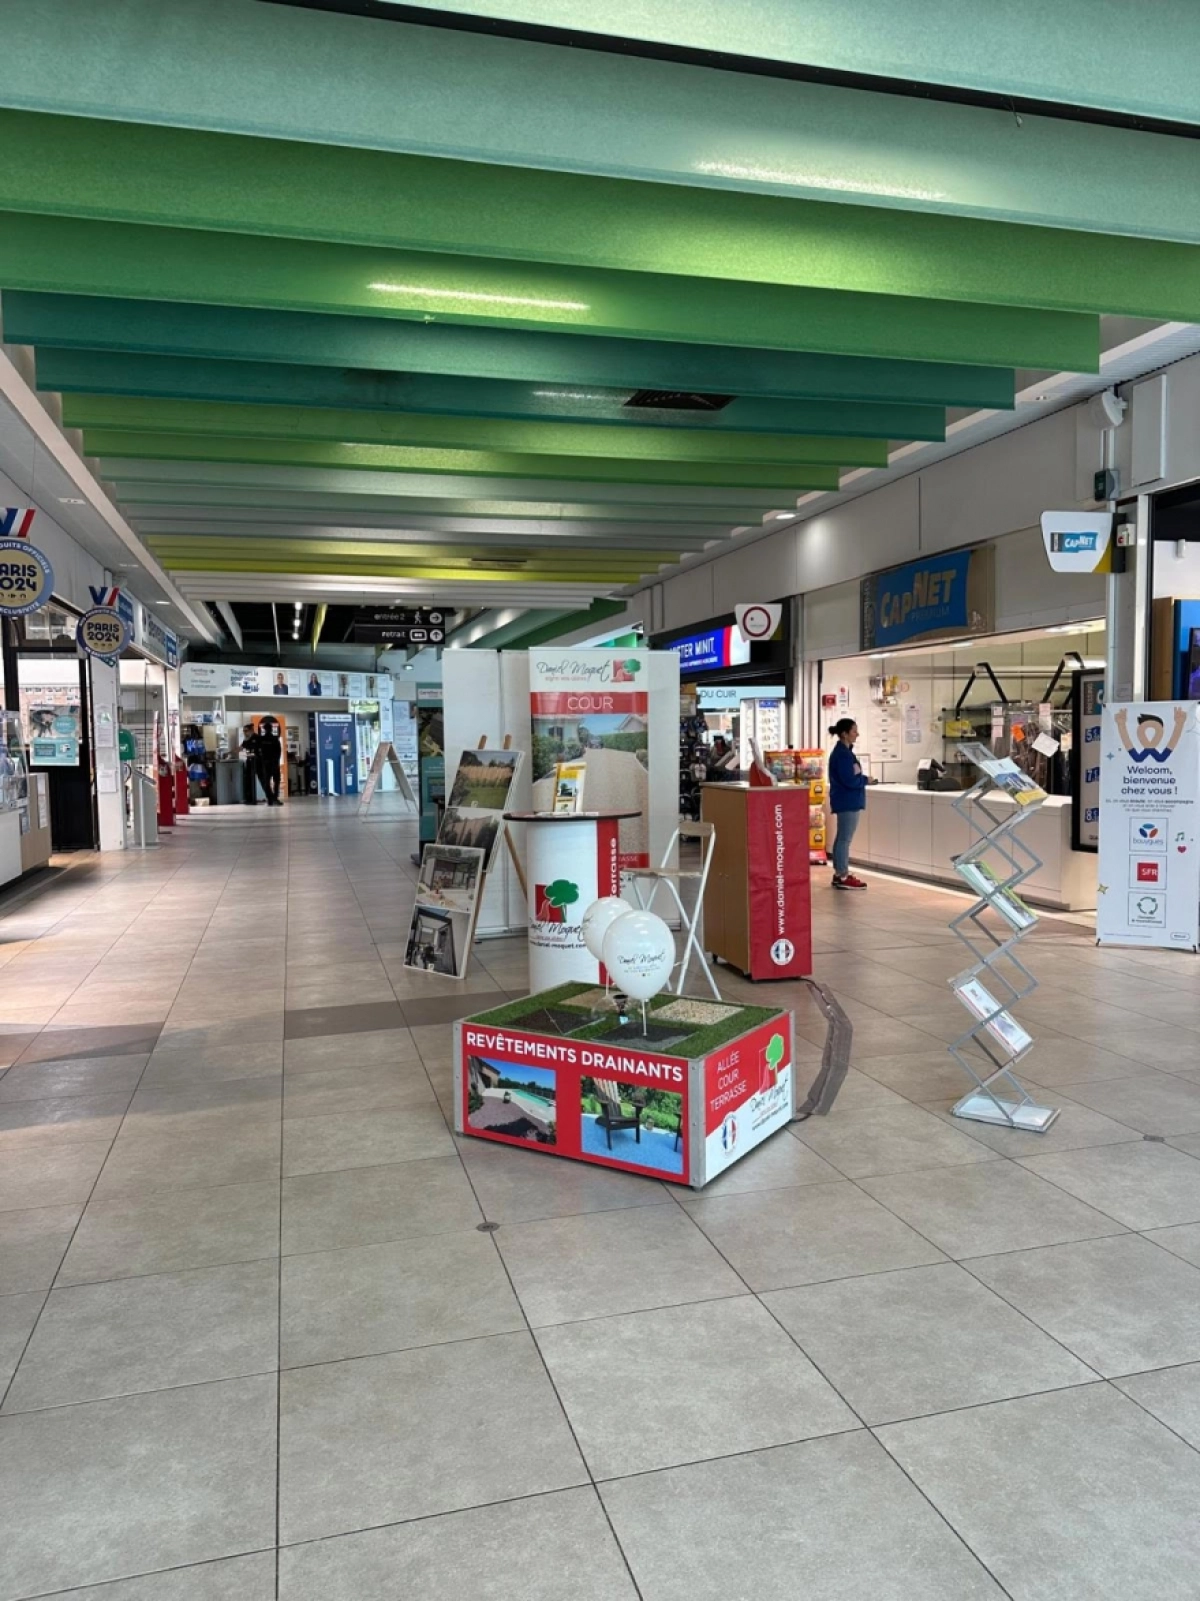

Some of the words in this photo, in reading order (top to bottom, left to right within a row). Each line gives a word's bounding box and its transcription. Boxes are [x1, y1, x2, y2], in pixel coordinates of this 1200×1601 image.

[0, 563, 37, 577] ARIS
[0, 577, 37, 591] 024
[374, 612, 399, 621] entrée
[400, 613, 405, 621] 2
[87, 622, 119, 633] PARIS
[87, 632, 119, 643] 2024
[695, 636, 715, 655] MINIT
[568, 659, 611, 682] Moquet
[716, 690, 737, 698] CUIR
[567, 695, 614, 710] COUR
[1127, 765, 1173, 775] Welcom,
[1123, 775, 1176, 785] bienvenue
[1121, 786, 1146, 795] chez
[1148, 787, 1172, 795] vous
[1174, 786, 1178, 795] !
[1132, 838, 1164, 846] bouygues
[775, 804, 785, 935] www.daniel-moquet.com
[1141, 868, 1158, 876] SFR
[466, 1031, 577, 1063] REVÊTEMENTS
[582, 1050, 683, 1082] DRAINANTS
[717, 1050, 740, 1074] ALLÉE
[718, 1068, 739, 1090] COUR
[710, 1080, 747, 1111] TERRASSE
